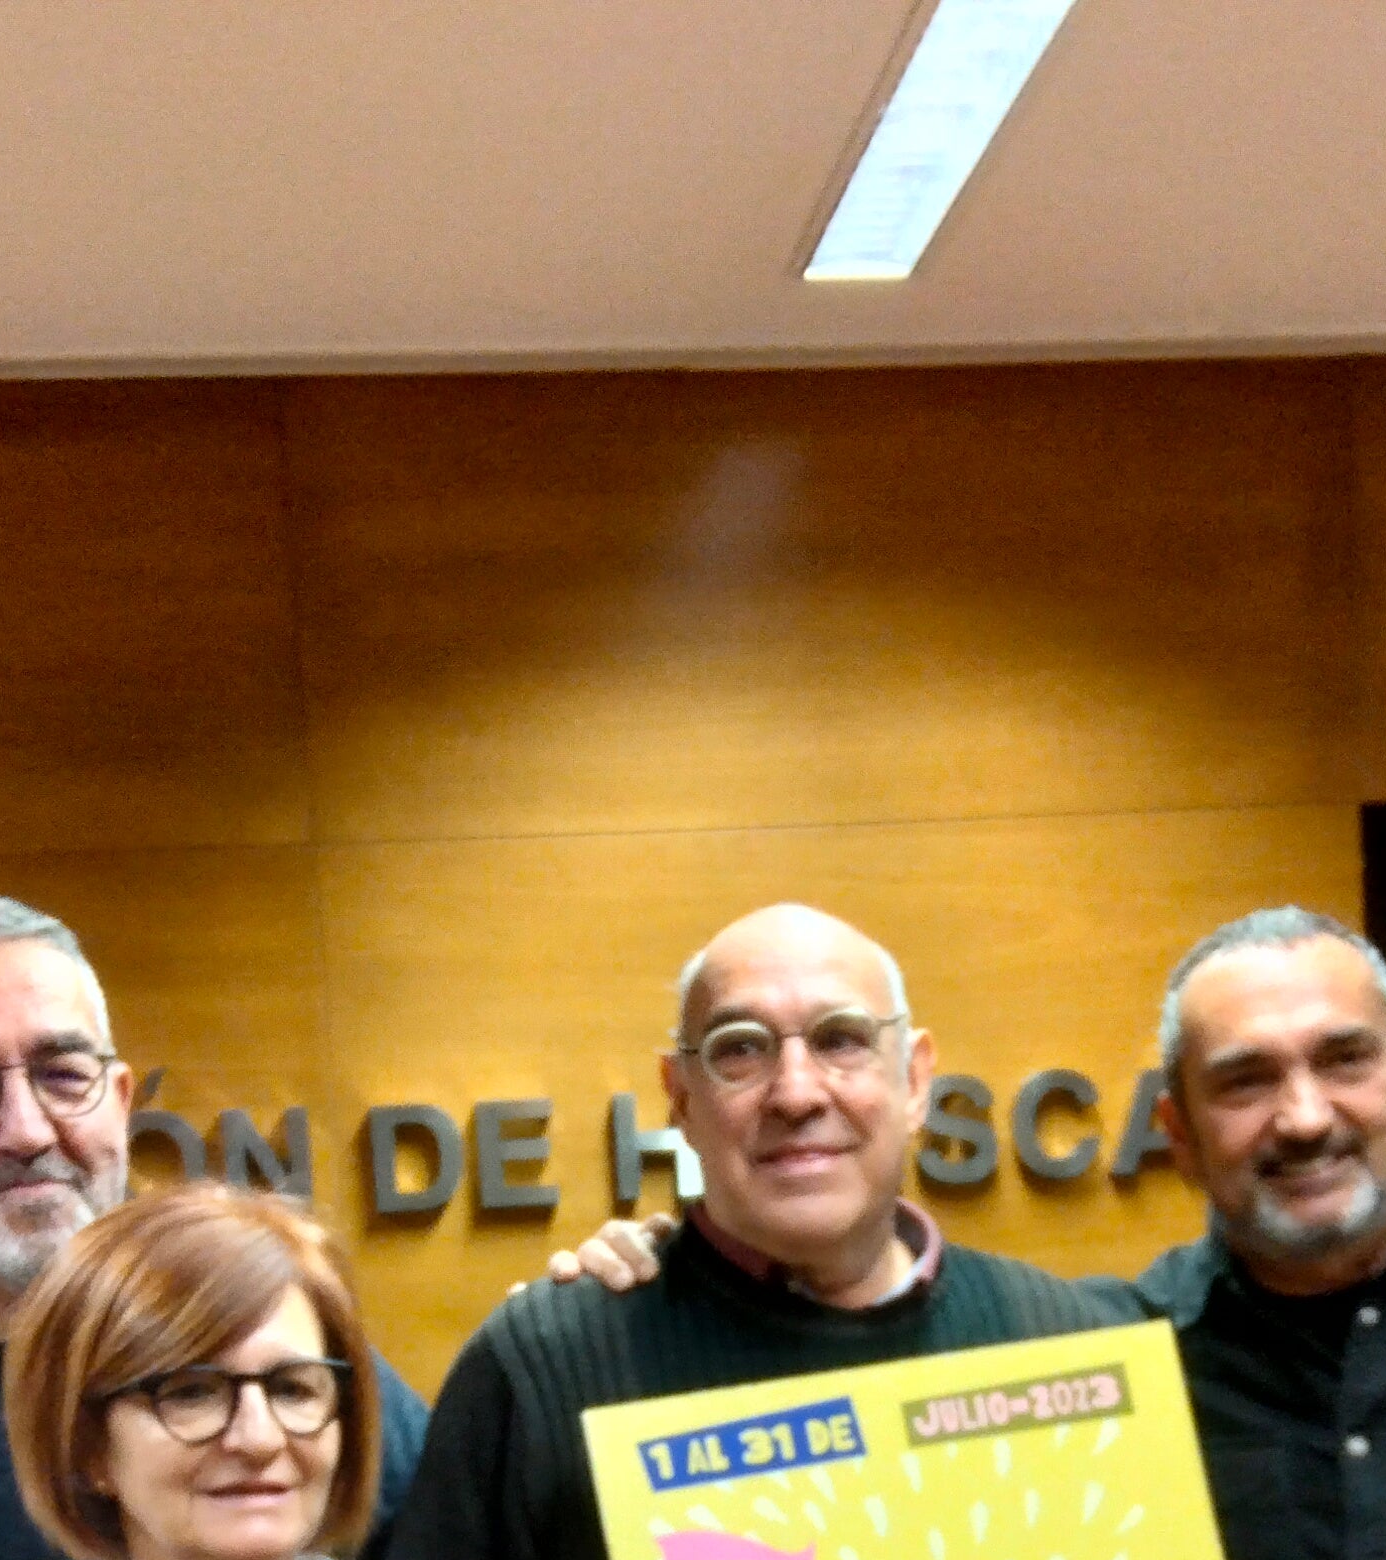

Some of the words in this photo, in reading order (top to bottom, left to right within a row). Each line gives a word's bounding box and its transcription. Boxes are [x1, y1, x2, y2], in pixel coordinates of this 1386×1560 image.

[367, 1098, 559, 1212] DE
[615, 1068, 1171, 1198] HSCA
[649, 1442, 675, 1480] 1
[686, 1434, 730, 1476] AL
[738, 1422, 796, 1466] 31
[804, 1413, 857, 1456] DE
